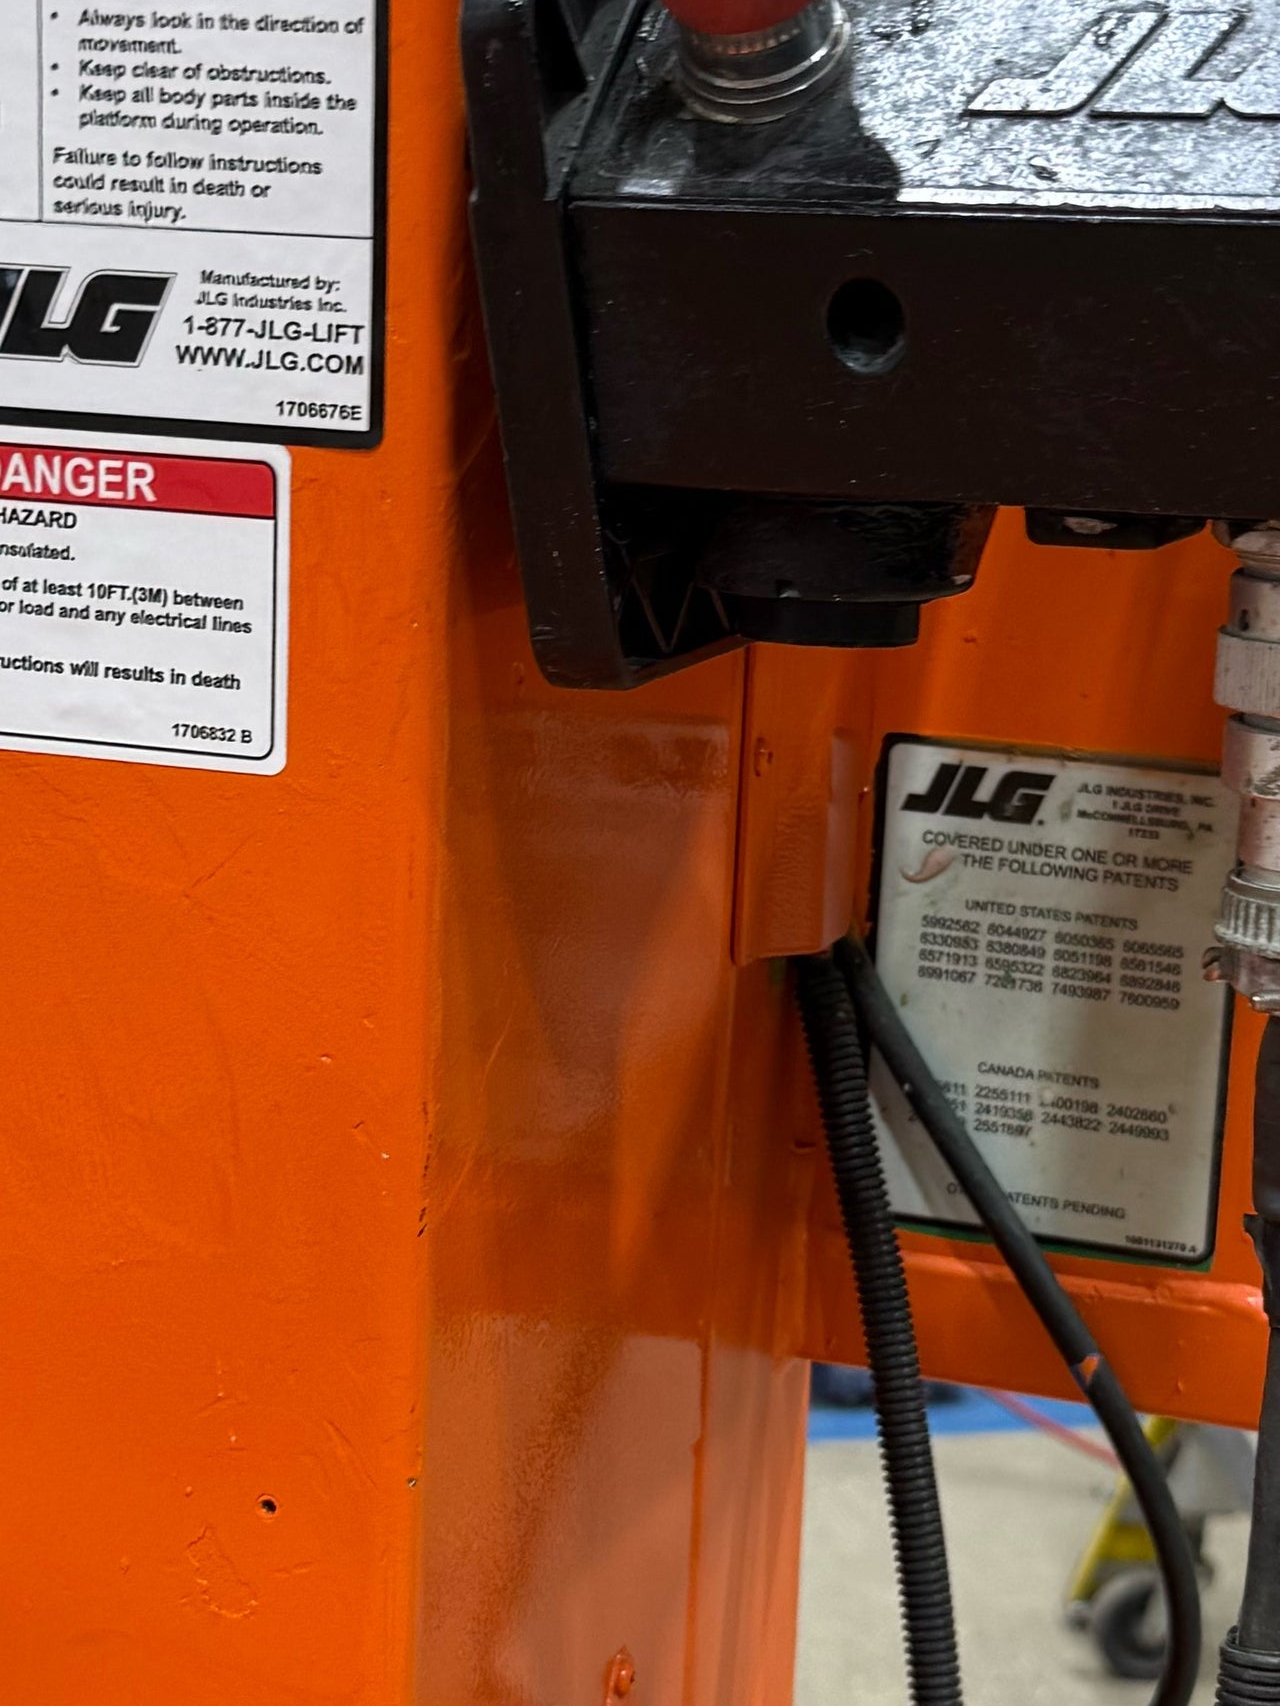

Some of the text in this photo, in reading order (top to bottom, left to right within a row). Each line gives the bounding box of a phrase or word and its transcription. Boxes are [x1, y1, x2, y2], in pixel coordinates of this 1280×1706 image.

[76, 8, 365, 35] Always look in the direction of
[77, 37, 182, 55] movement.
[77, 58, 332, 85] Keep clear of obstructions.
[78, 83, 357, 111] Keep all body parts inside the
[78, 108, 324, 136] platform during operation.
[51, 145, 323, 175] Failure to follow instructions
[51, 172, 272, 198] could result in death or
[52, 197, 187, 224] serious injury.
[199, 268, 341, 295] Manufactured by:
[194, 290, 347, 313] JLG Industries Inc.
[182, 314, 366, 344] 1-877-JLG-LIFT
[174, 344, 364, 375] WWW.JLG.COM
[274, 399, 363, 421] 1706676E
[0, 575, 19, 592] of
[20, 578, 39, 594] at
[41, 577, 83, 598] least
[85, 582, 168, 608] 10FT.(3M)
[171, 588, 244, 611] between
[17, 598, 55, 617] load
[57, 604, 90, 620] and
[93, 608, 126, 627] any
[129, 608, 207, 630] electrical
[210, 614, 252, 634] lines
[68, 659, 99, 678] will
[102, 665, 165, 683] results
[168, 667, 187, 686] in
[189, 669, 241, 690] death
[170, 722, 253, 744] 1706832 B
[900, 761, 1057, 826] JLG
[1075, 781, 1103, 796] JLG
[920, 828, 1193, 875] COVERED UNDER ONE OR MORE
[959, 851, 1179, 892] THE FOLLOWING PATENTS
[963, 898, 1138, 931] UNITED STATES PATENTS
[976, 1060, 1100, 1089] CANADA PATENTS
[1060, 1198, 1126, 1220] PENDING
